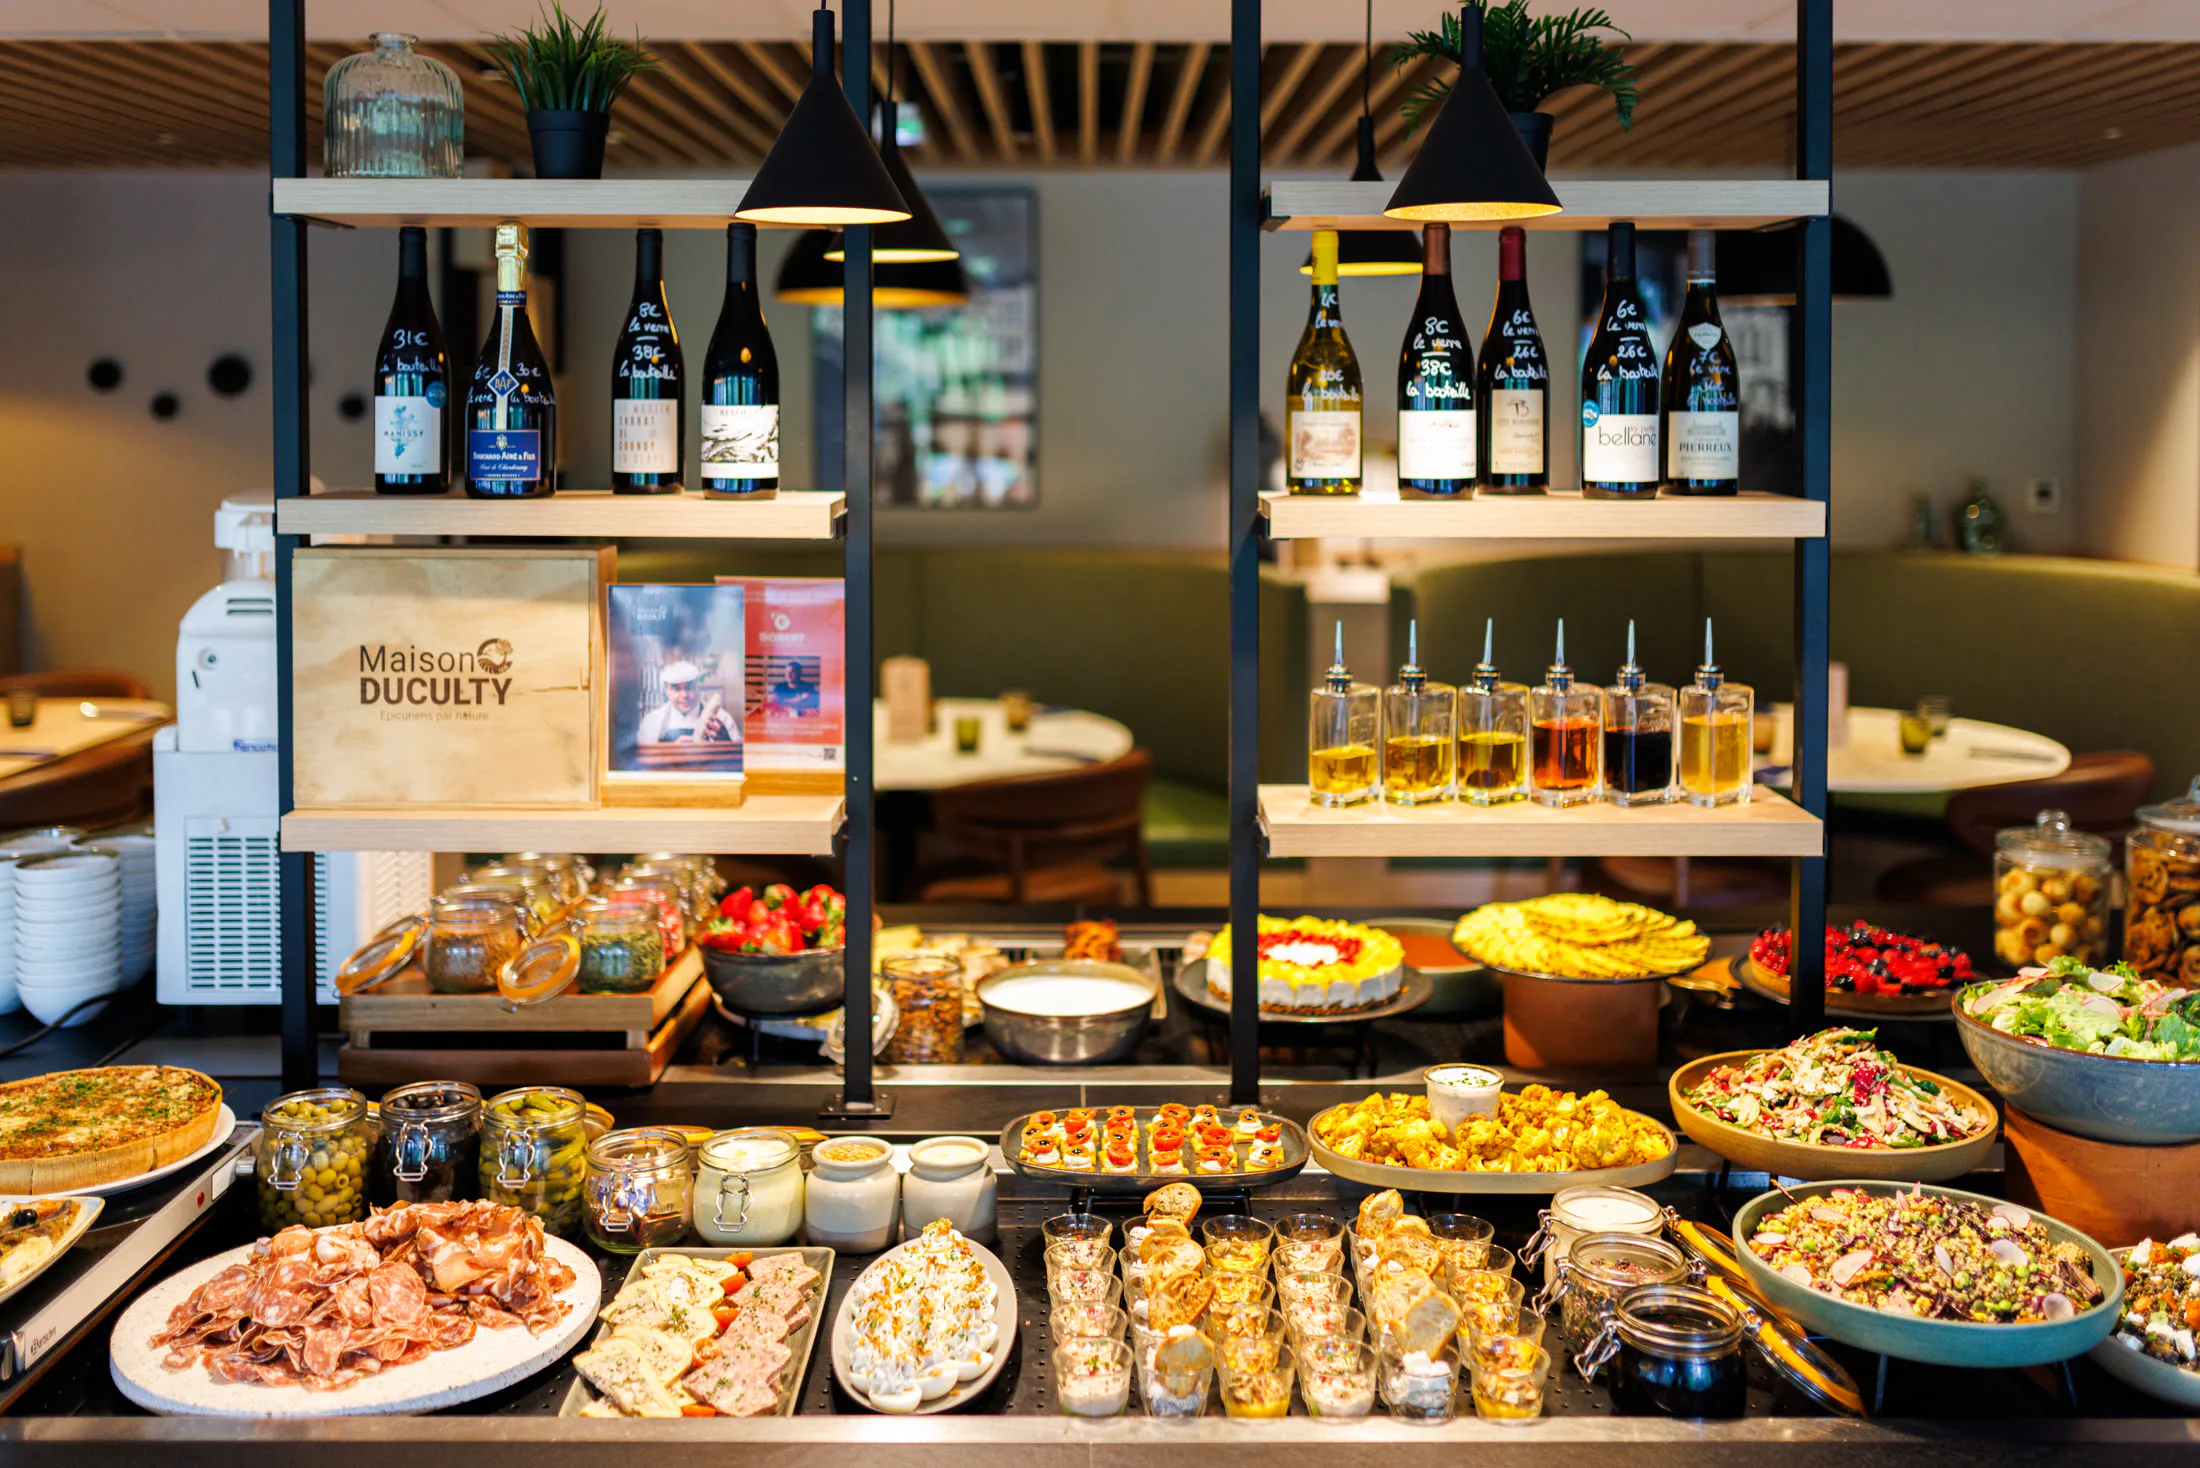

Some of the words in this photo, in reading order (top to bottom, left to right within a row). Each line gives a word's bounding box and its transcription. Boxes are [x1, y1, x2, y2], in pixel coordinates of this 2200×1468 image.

[1616, 299, 1638, 319] 6€
[393, 329, 429, 350] 31€
[515, 362, 542, 377] 30€
[494, 376, 512, 391] BAF
[1406, 380, 1421, 397] la
[1598, 425, 1657, 447] bellane
[1679, 442, 1732, 452] PIERREUX
[360, 645, 475, 673] Maison
[360, 677, 512, 705] DUCULTY
[436, 713, 452, 724] par
[455, 710, 489, 721] nature
